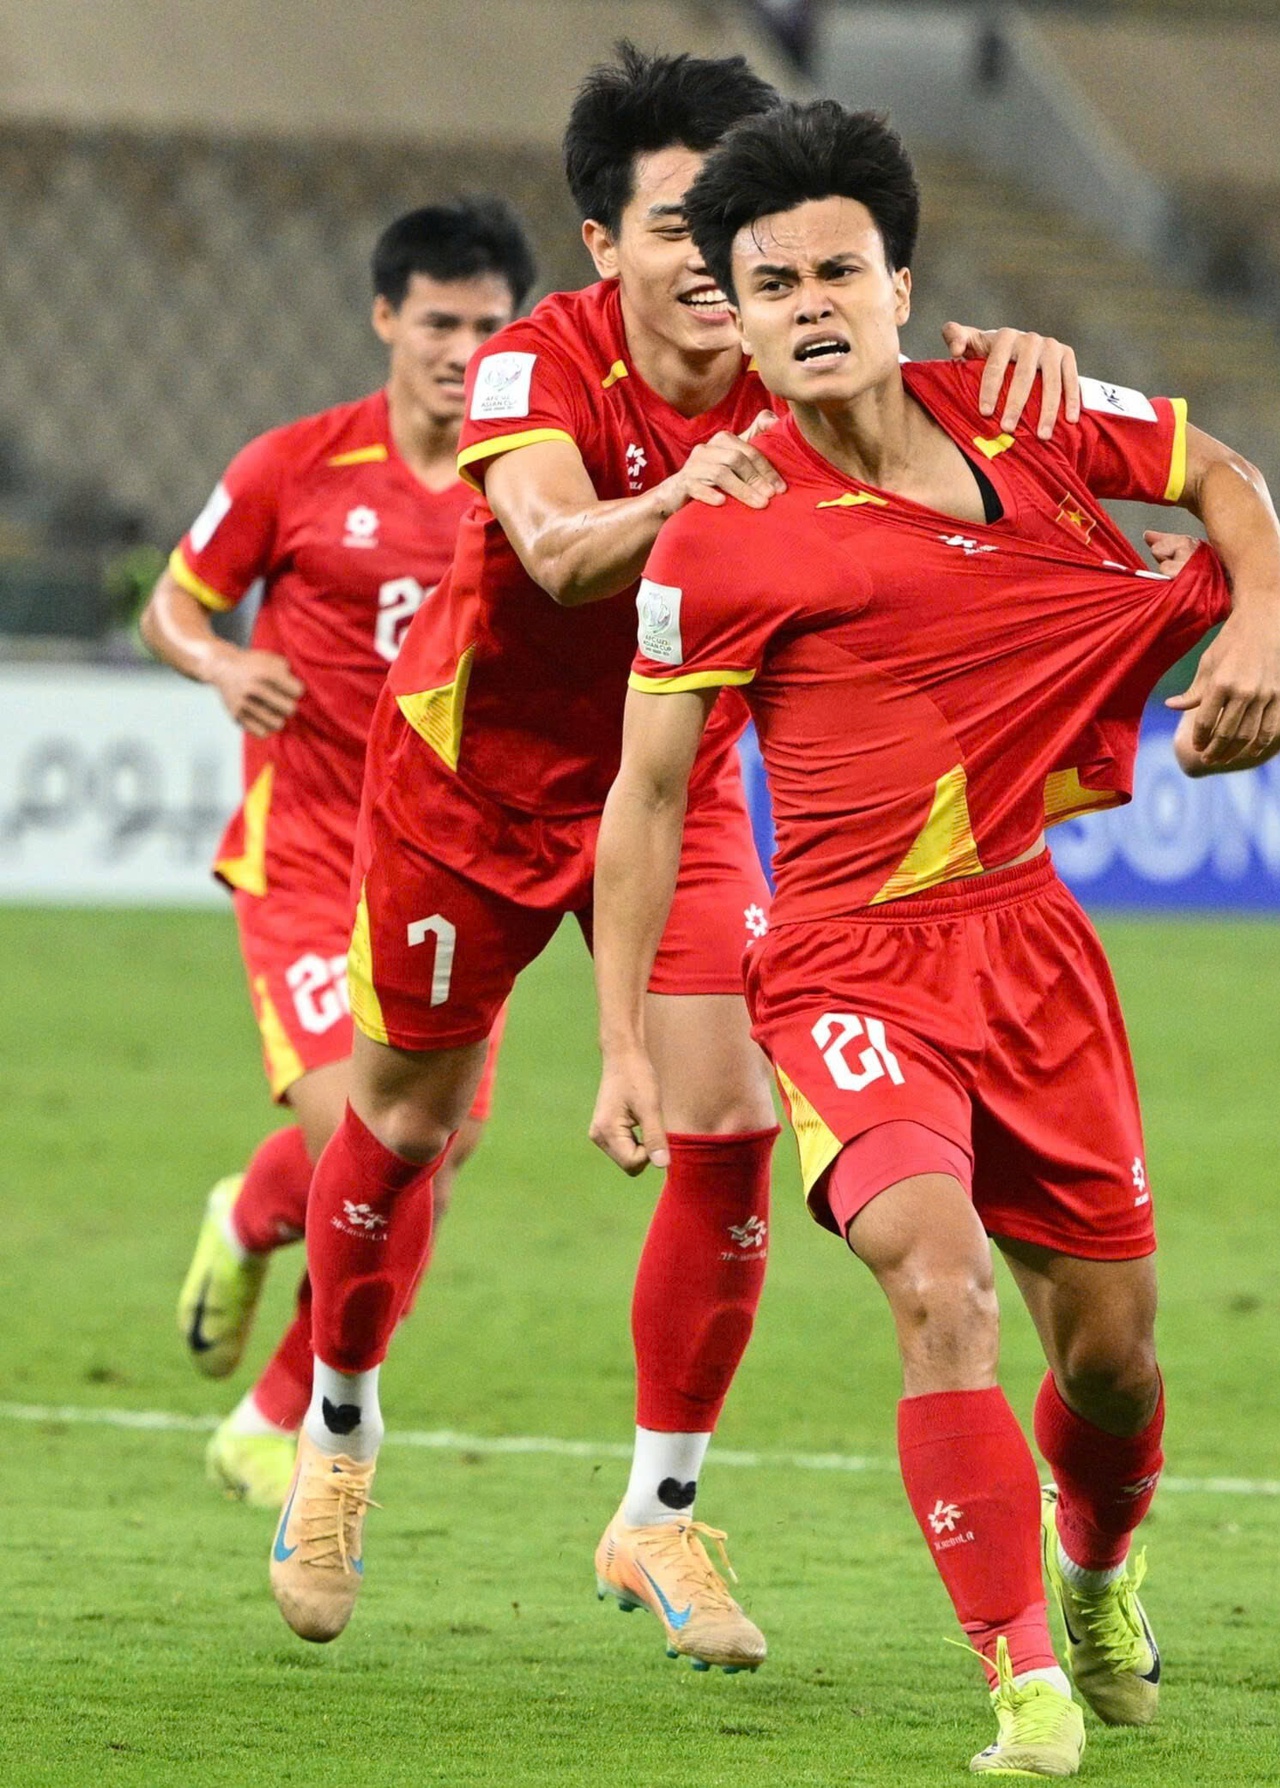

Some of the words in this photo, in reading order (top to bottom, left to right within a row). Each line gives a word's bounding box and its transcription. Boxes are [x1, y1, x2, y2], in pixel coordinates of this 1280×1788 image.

[374, 575, 438, 663] 2
[407, 914, 456, 1005] 7
[810, 1012, 906, 1092] 21
